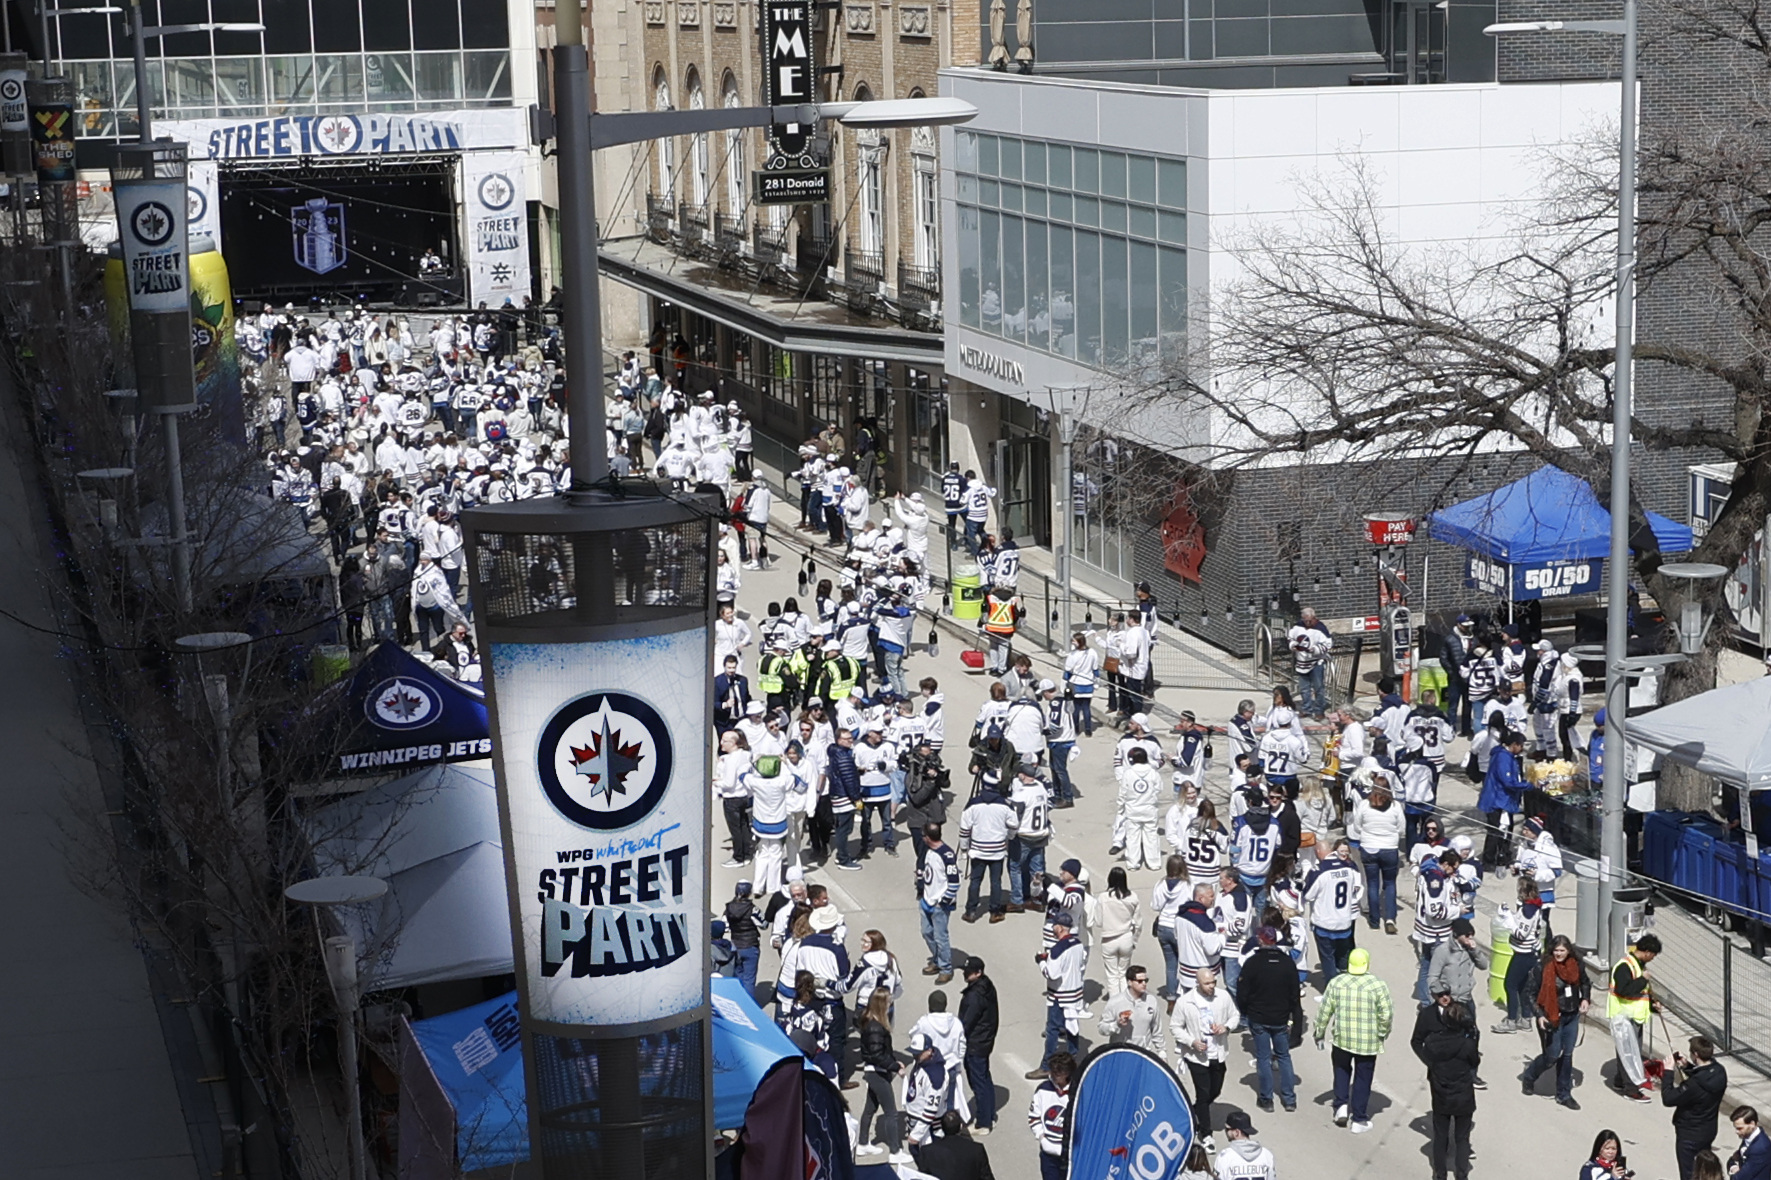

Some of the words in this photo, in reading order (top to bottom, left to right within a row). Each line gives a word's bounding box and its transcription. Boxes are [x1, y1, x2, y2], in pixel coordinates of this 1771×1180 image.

[772, 8, 804, 21] THE
[772, 25, 808, 134] ME
[207, 116, 313, 158] STREET
[363, 113, 465, 152] PARTY
[38, 151, 74, 159] SHED
[42, 143, 68, 151] THE
[765, 179, 784, 190] 281
[786, 176, 825, 189] Donald
[477, 216, 520, 232] STREET
[132, 252, 182, 271] STREET
[960, 344, 1025, 387] METROPOLITAN
[406, 408, 420, 420] 26
[943, 484, 960, 501] 26
[974, 493, 987, 508] 29
[1387, 521, 1407, 532] PAY
[1383, 531, 1410, 542] HERE
[1470, 558, 1506, 588] 50/50
[1525, 564, 1591, 590] 50/50
[1541, 585, 1572, 597] DRAW
[1473, 667, 1496, 687] 55
[846, 716, 857, 726] 81
[340, 743, 443, 770] WINNIPEG
[446, 738, 492, 757] JETS
[1268, 750, 1290, 773] 27
[557, 849, 594, 863] WPG
[596, 822, 681, 860] whiteout
[1188, 837, 1216, 864] 55
[1249, 837, 1269, 863] 16
[538, 845, 690, 906] STREET
[1334, 880, 1348, 910] 8
[541, 897, 691, 977] PARTY
[927, 1094, 941, 1107] 33
